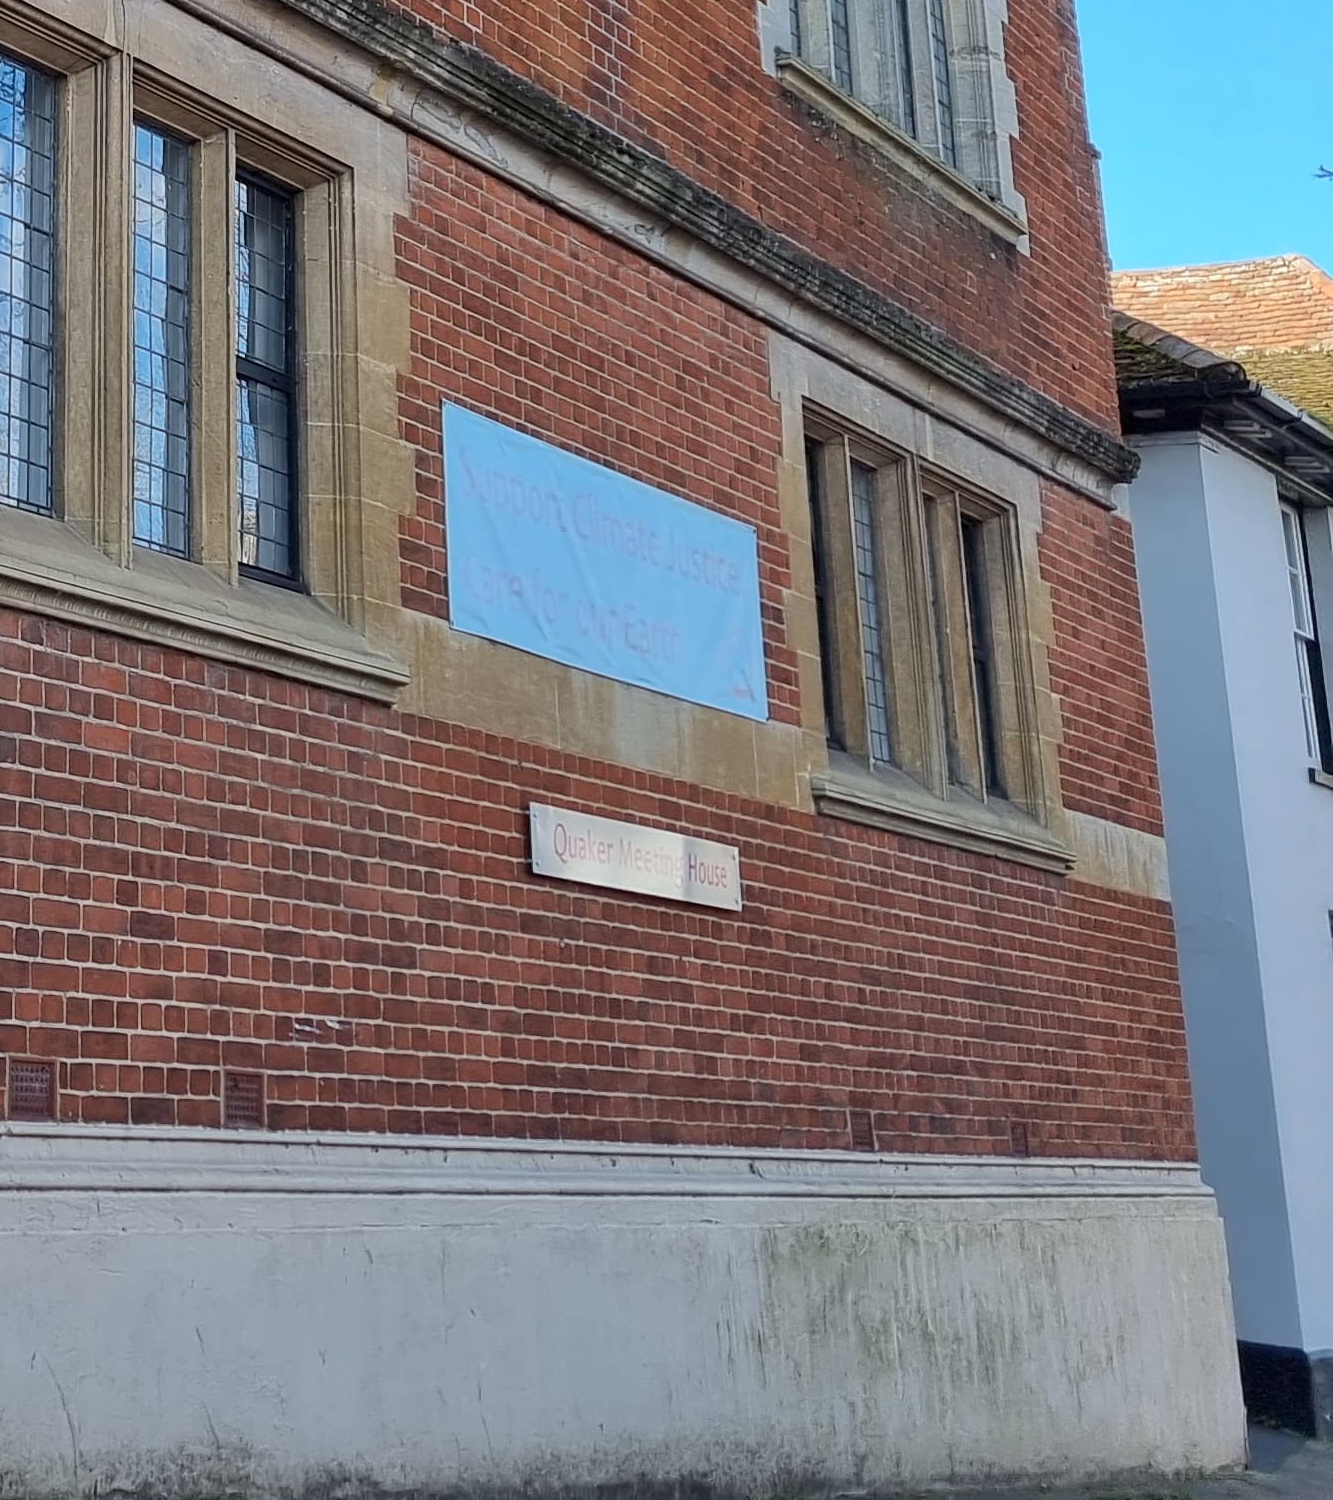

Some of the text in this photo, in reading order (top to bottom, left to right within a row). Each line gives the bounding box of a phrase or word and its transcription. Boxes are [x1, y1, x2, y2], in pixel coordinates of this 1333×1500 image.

[459, 446, 567, 533] Support
[572, 492, 660, 567] Climate
[463, 553, 525, 614] Care
[533, 569, 566, 625] for
[576, 600, 619, 642] our
[553, 822, 728, 888] Quaker Meeting House
